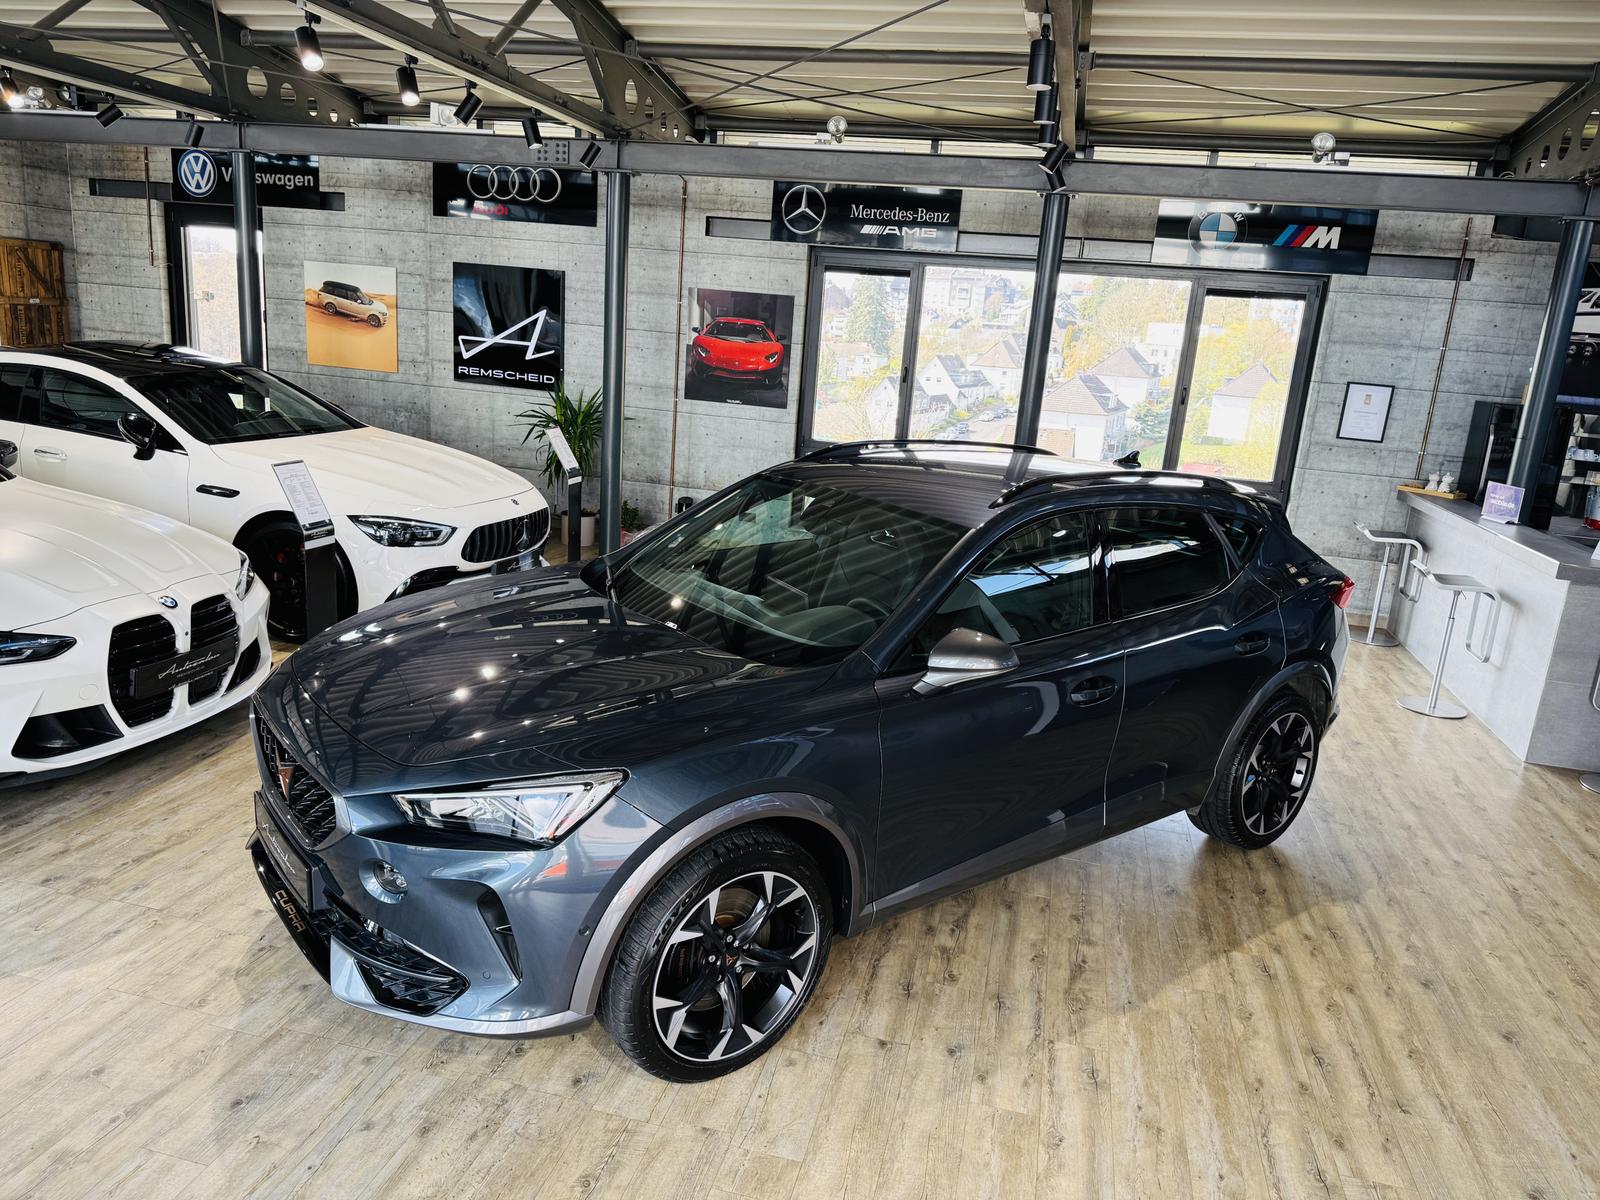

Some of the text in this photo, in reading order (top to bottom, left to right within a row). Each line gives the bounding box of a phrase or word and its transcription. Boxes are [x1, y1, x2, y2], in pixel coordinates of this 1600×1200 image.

[221, 166, 314, 189] Vswagen
[850, 204, 950, 223] Mercedes-Benz
[882, 226, 938, 238] AMG
[458, 366, 555, 384] REMSCHEID
[274, 889, 306, 933] CUPRA
[651, 890, 695, 949] TOYO
